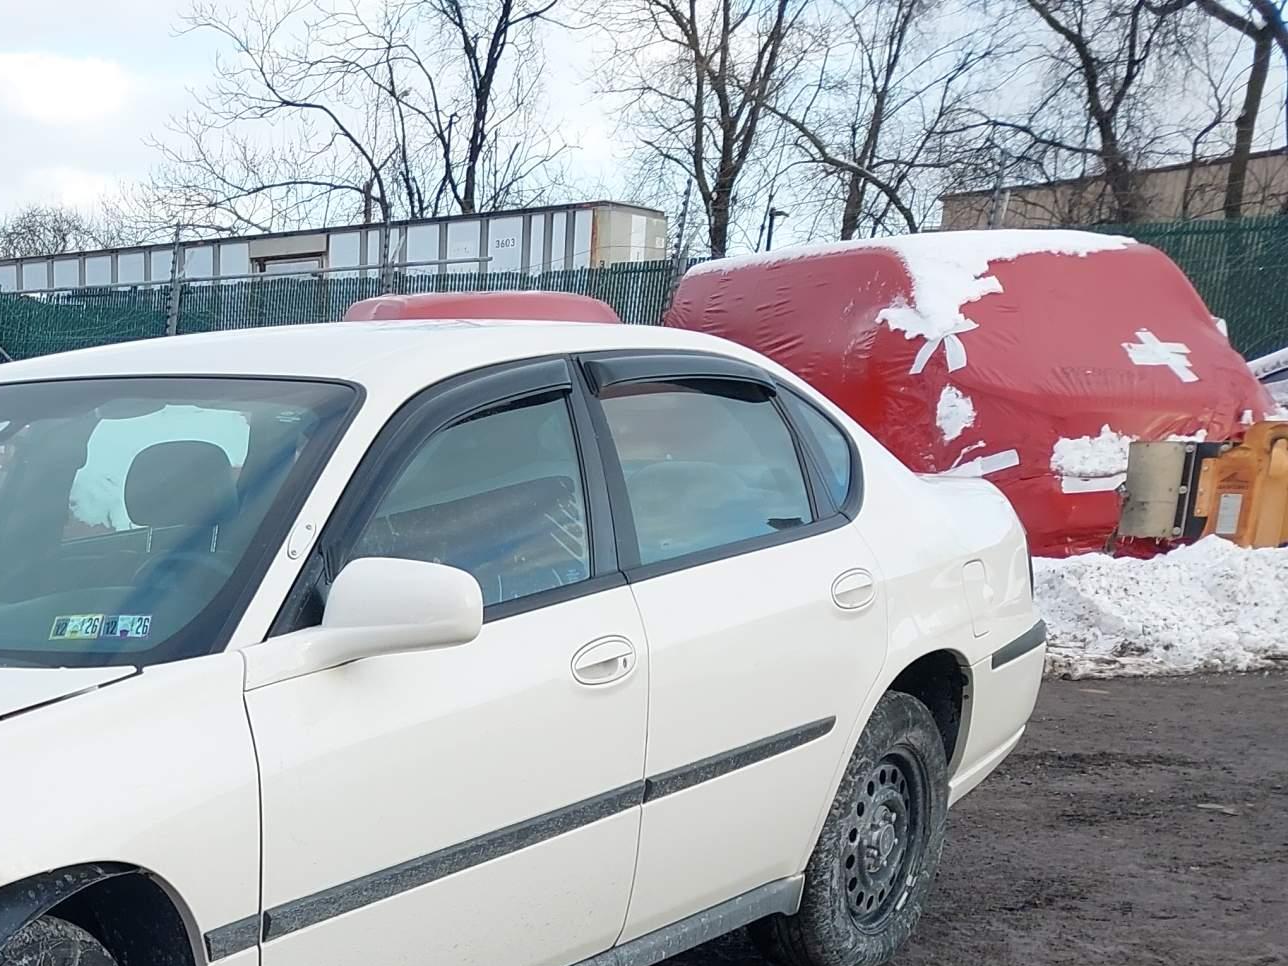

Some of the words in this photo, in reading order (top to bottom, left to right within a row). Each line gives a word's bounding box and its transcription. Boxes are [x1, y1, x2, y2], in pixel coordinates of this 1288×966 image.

[495, 238, 515, 248] 3603
[85, 617, 99, 634] 26
[135, 617, 150, 635] 26
